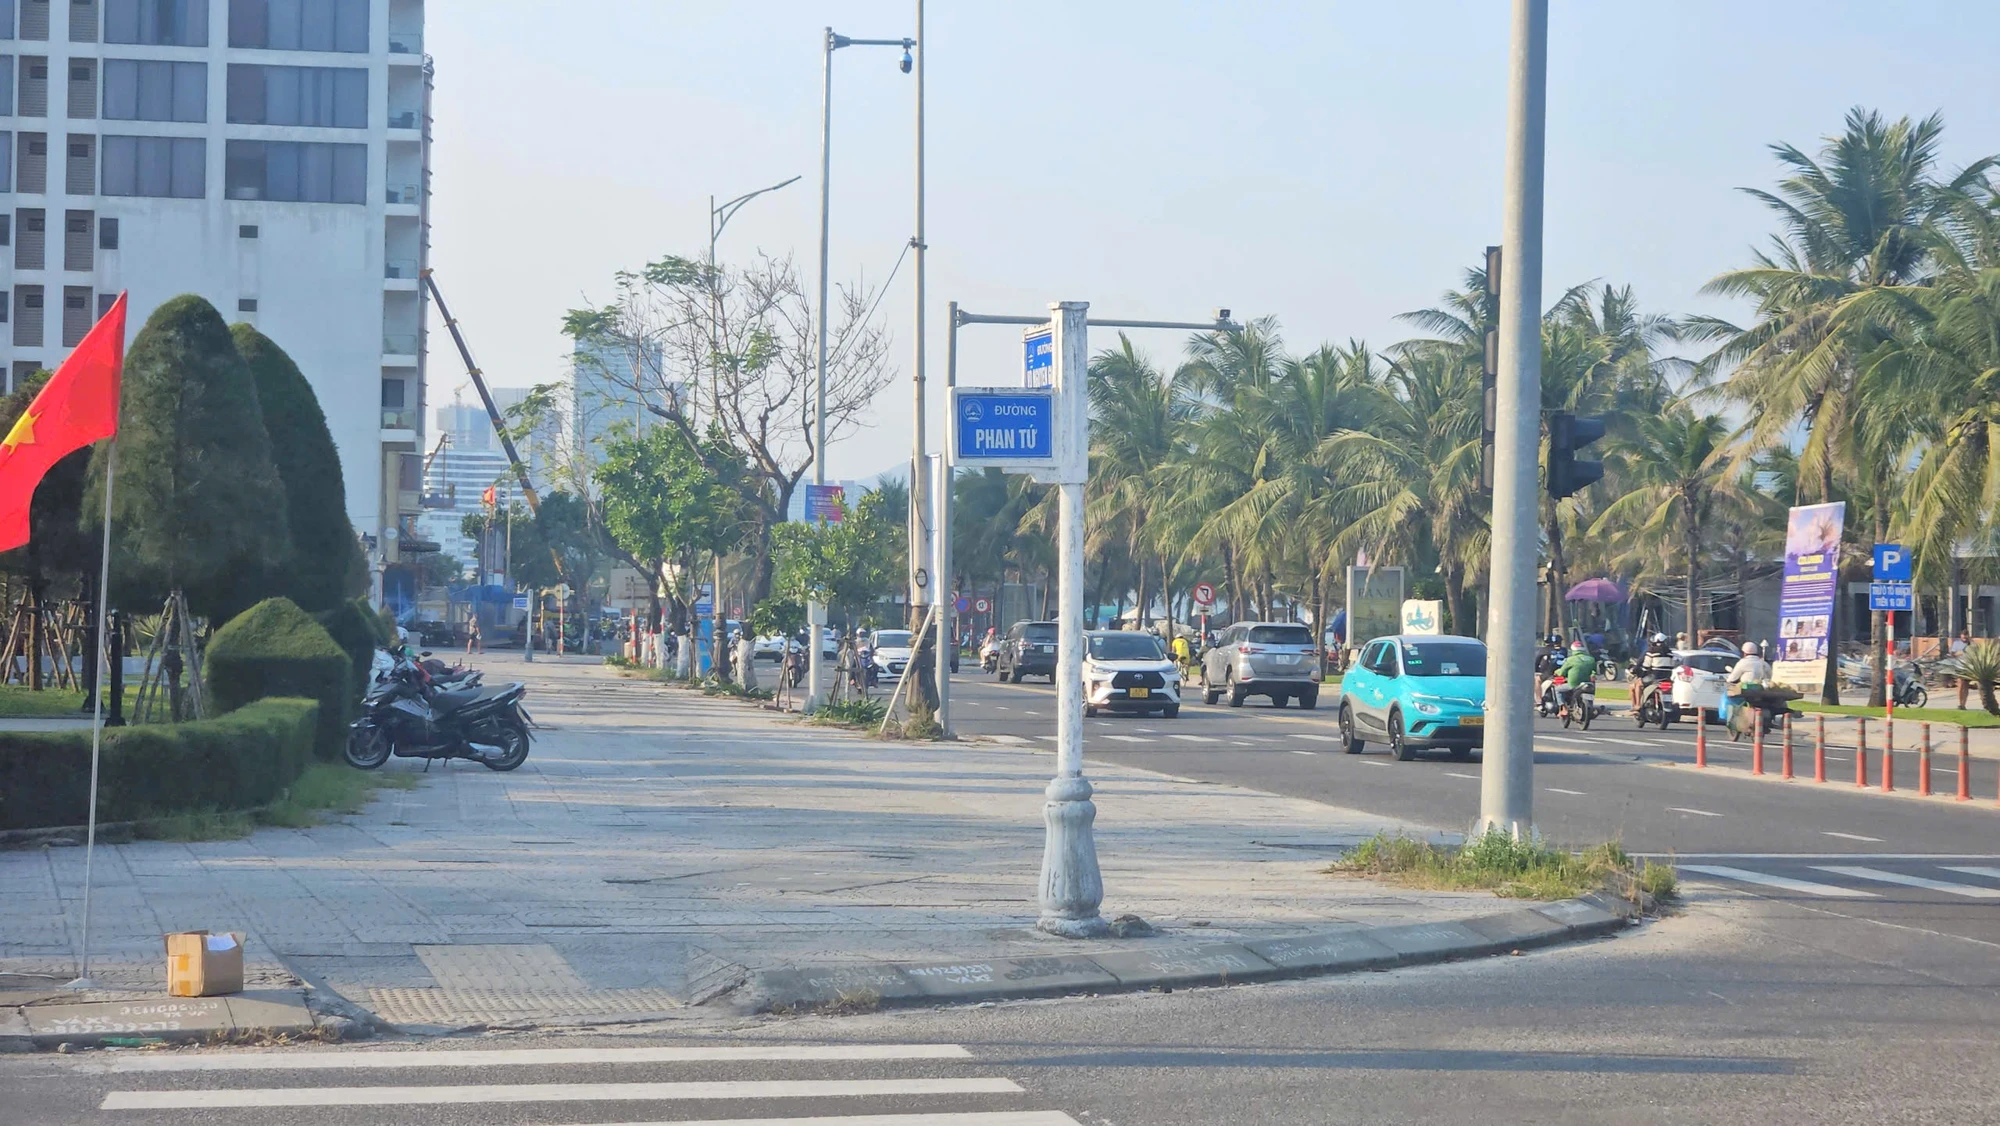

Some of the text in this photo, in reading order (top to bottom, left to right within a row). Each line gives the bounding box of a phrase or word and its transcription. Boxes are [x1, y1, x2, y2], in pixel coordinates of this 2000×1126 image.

[994, 402, 1037, 416] ĐƯỜNG
[975, 423, 1038, 449] PHAN TỨ
[1882, 550, 1901, 571] P
